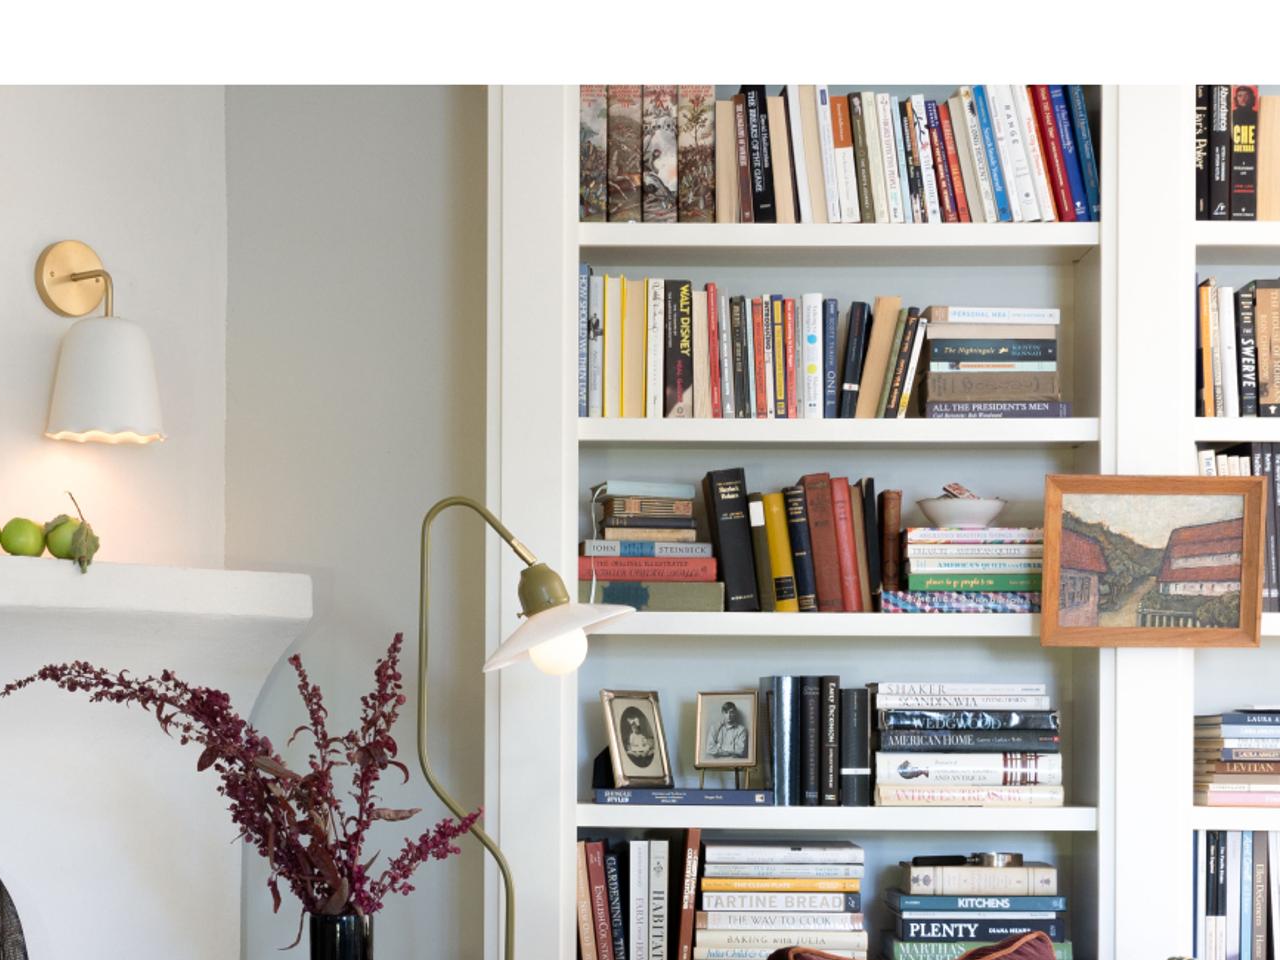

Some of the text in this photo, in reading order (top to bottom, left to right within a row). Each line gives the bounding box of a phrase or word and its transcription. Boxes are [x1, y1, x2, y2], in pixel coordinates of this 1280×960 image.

[1220, 86, 1228, 131] Abundance
[1003, 103, 1019, 145] RANGE
[1196, 106, 1207, 170] Liar's Poker
[1234, 125, 1255, 144] CHE
[751, 139, 759, 150] OF
[752, 151, 760, 166] THE
[753, 168, 763, 192] GAME
[579, 275, 587, 299] HOW
[579, 301, 587, 337] SHOULD
[680, 284, 690, 357] WALT DISNEY
[1271, 311, 1280, 342] HOUSE
[958, 346, 995, 356] Nightingale
[1273, 345, 1280, 358] OF
[579, 357, 587, 381] THEN
[1241, 338, 1255, 388] SWERVE
[827, 371, 836, 394] ONE
[592, 544, 616, 552] JOHN
[887, 684, 946, 694] SHAKER
[899, 698, 978, 707] SCANDINAVIA
[913, 718, 1001, 728] WEDGWOOD
[888, 736, 940, 745] AMERICAN
[943, 736, 975, 745] HOME
[1226, 763, 1274, 772] LEVITAN
[607, 856, 622, 926] GARDENING
[595, 884, 604, 922] ENGLISH
[636, 897, 644, 924] FARM
[705, 895, 842, 908] TARTINE BREAD
[958, 898, 1010, 908] KITCHENS
[728, 916, 831, 925] THE WAY TO COOK
[1255, 864, 1264, 959] Ellen DeGeneres Home
[652, 891, 665, 960] HABITAT
[910, 923, 979, 938] PLENTY
[796, 937, 826, 945] JULIA
[900, 943, 966, 954] MARTHA'S
